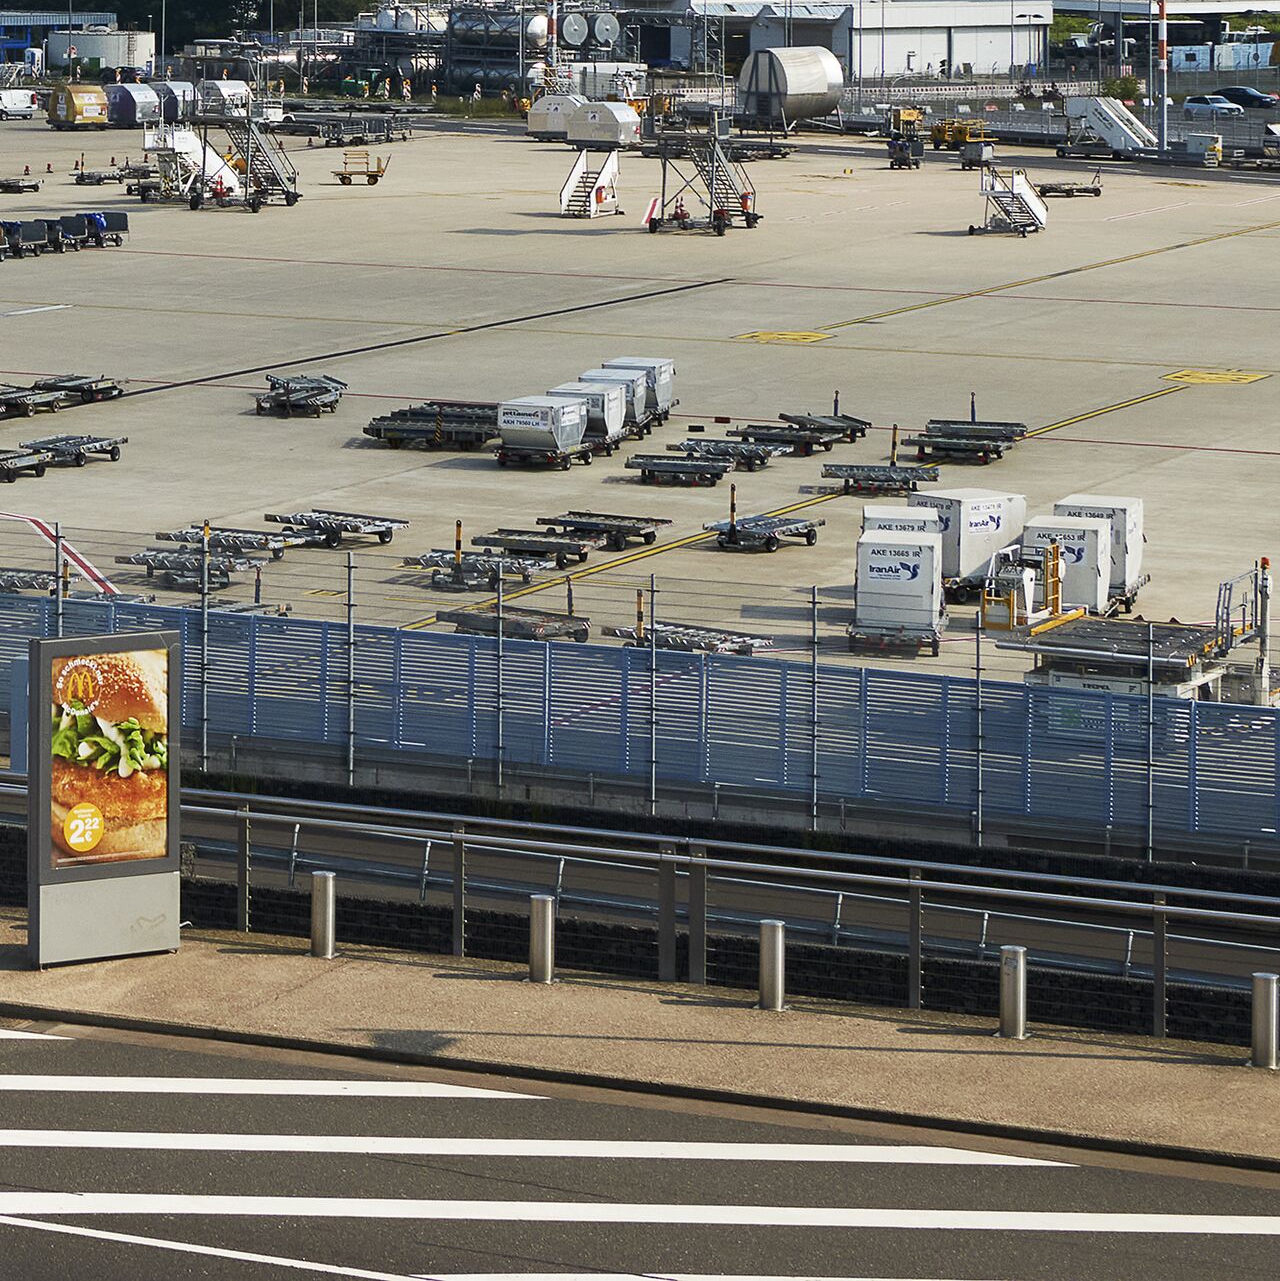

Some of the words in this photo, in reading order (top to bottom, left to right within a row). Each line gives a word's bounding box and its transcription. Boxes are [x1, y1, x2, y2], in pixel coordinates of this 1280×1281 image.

[1066, 510, 1082, 518] AKE
[877, 523, 893, 531] AKE
[968, 520, 989, 528] IranAir
[871, 548, 887, 556] AKE
[912, 550, 921, 558] IR
[869, 564, 902, 574] IranAir
